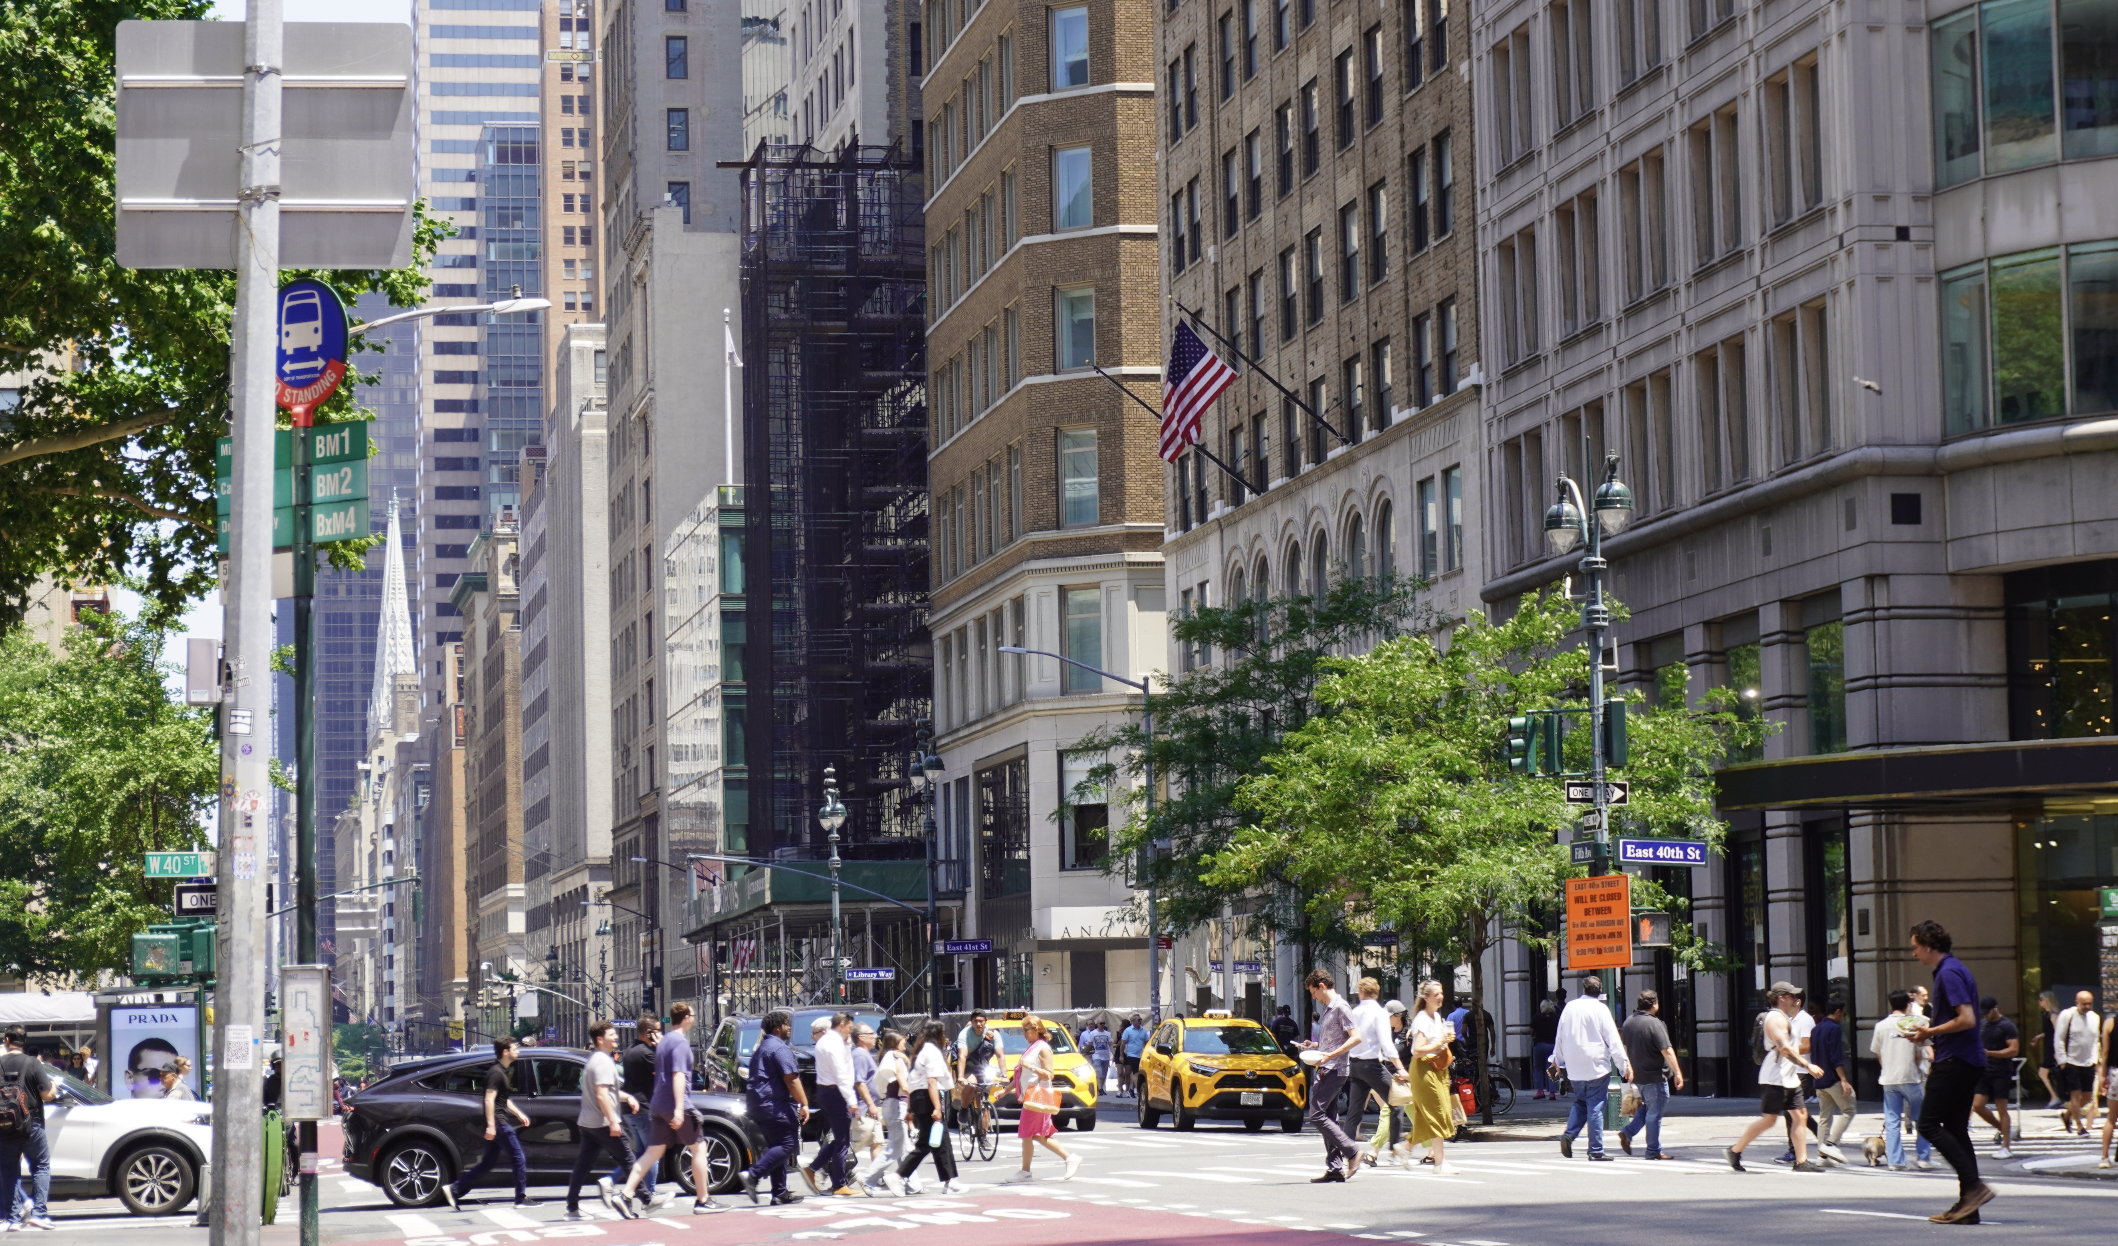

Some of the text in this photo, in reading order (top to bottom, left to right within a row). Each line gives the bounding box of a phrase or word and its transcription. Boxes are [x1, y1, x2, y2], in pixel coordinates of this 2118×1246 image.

[283, 369, 337, 404] STANDING
[316, 427, 350, 458] BM1
[316, 466, 352, 498] BM2
[316, 506, 356, 537] BxM4
[1572, 788, 1589, 798] ONE
[1626, 844, 1700, 860] East 40th St
[149, 856, 196, 874] W 40 ST
[1574, 883, 1587, 891] EAST
[1601, 880, 1619, 888] STREET
[190, 895, 216, 907] ONE
[1574, 892, 1622, 904] WILL BE CLOSED
[1584, 906, 1612, 916] BETWEEN
[1587, 947, 1595, 955] PM
[1597, 947, 1603, 955] to
[853, 970, 893, 979] Library Way
[128, 1013, 178, 1024] PRADA
